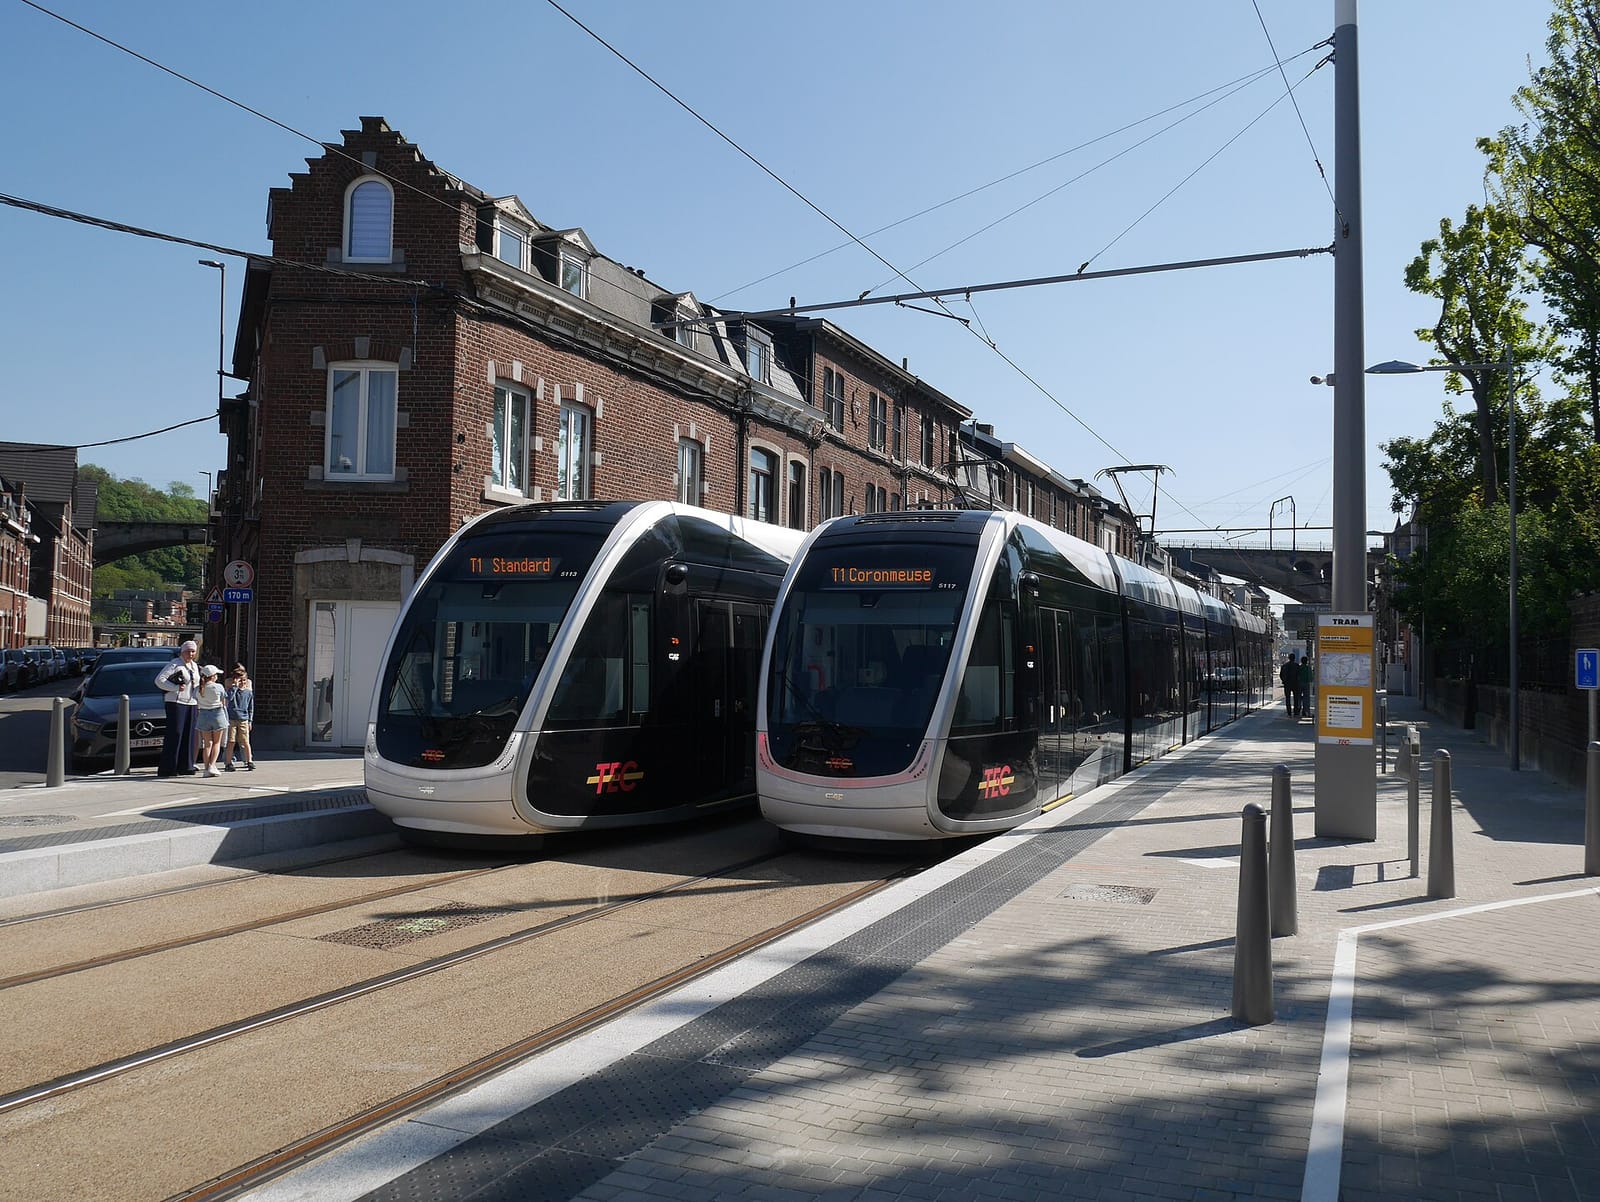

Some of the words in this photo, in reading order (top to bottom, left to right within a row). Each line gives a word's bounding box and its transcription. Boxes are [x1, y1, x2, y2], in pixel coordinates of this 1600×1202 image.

[470, 558, 482, 573] T1
[492, 558, 551, 573] Standard
[832, 568, 845, 582] T1
[849, 567, 931, 582] Coronmeuse
[228, 591, 241, 599] 170
[594, 760, 640, 795] TEC
[983, 764, 1011, 799] TEC
